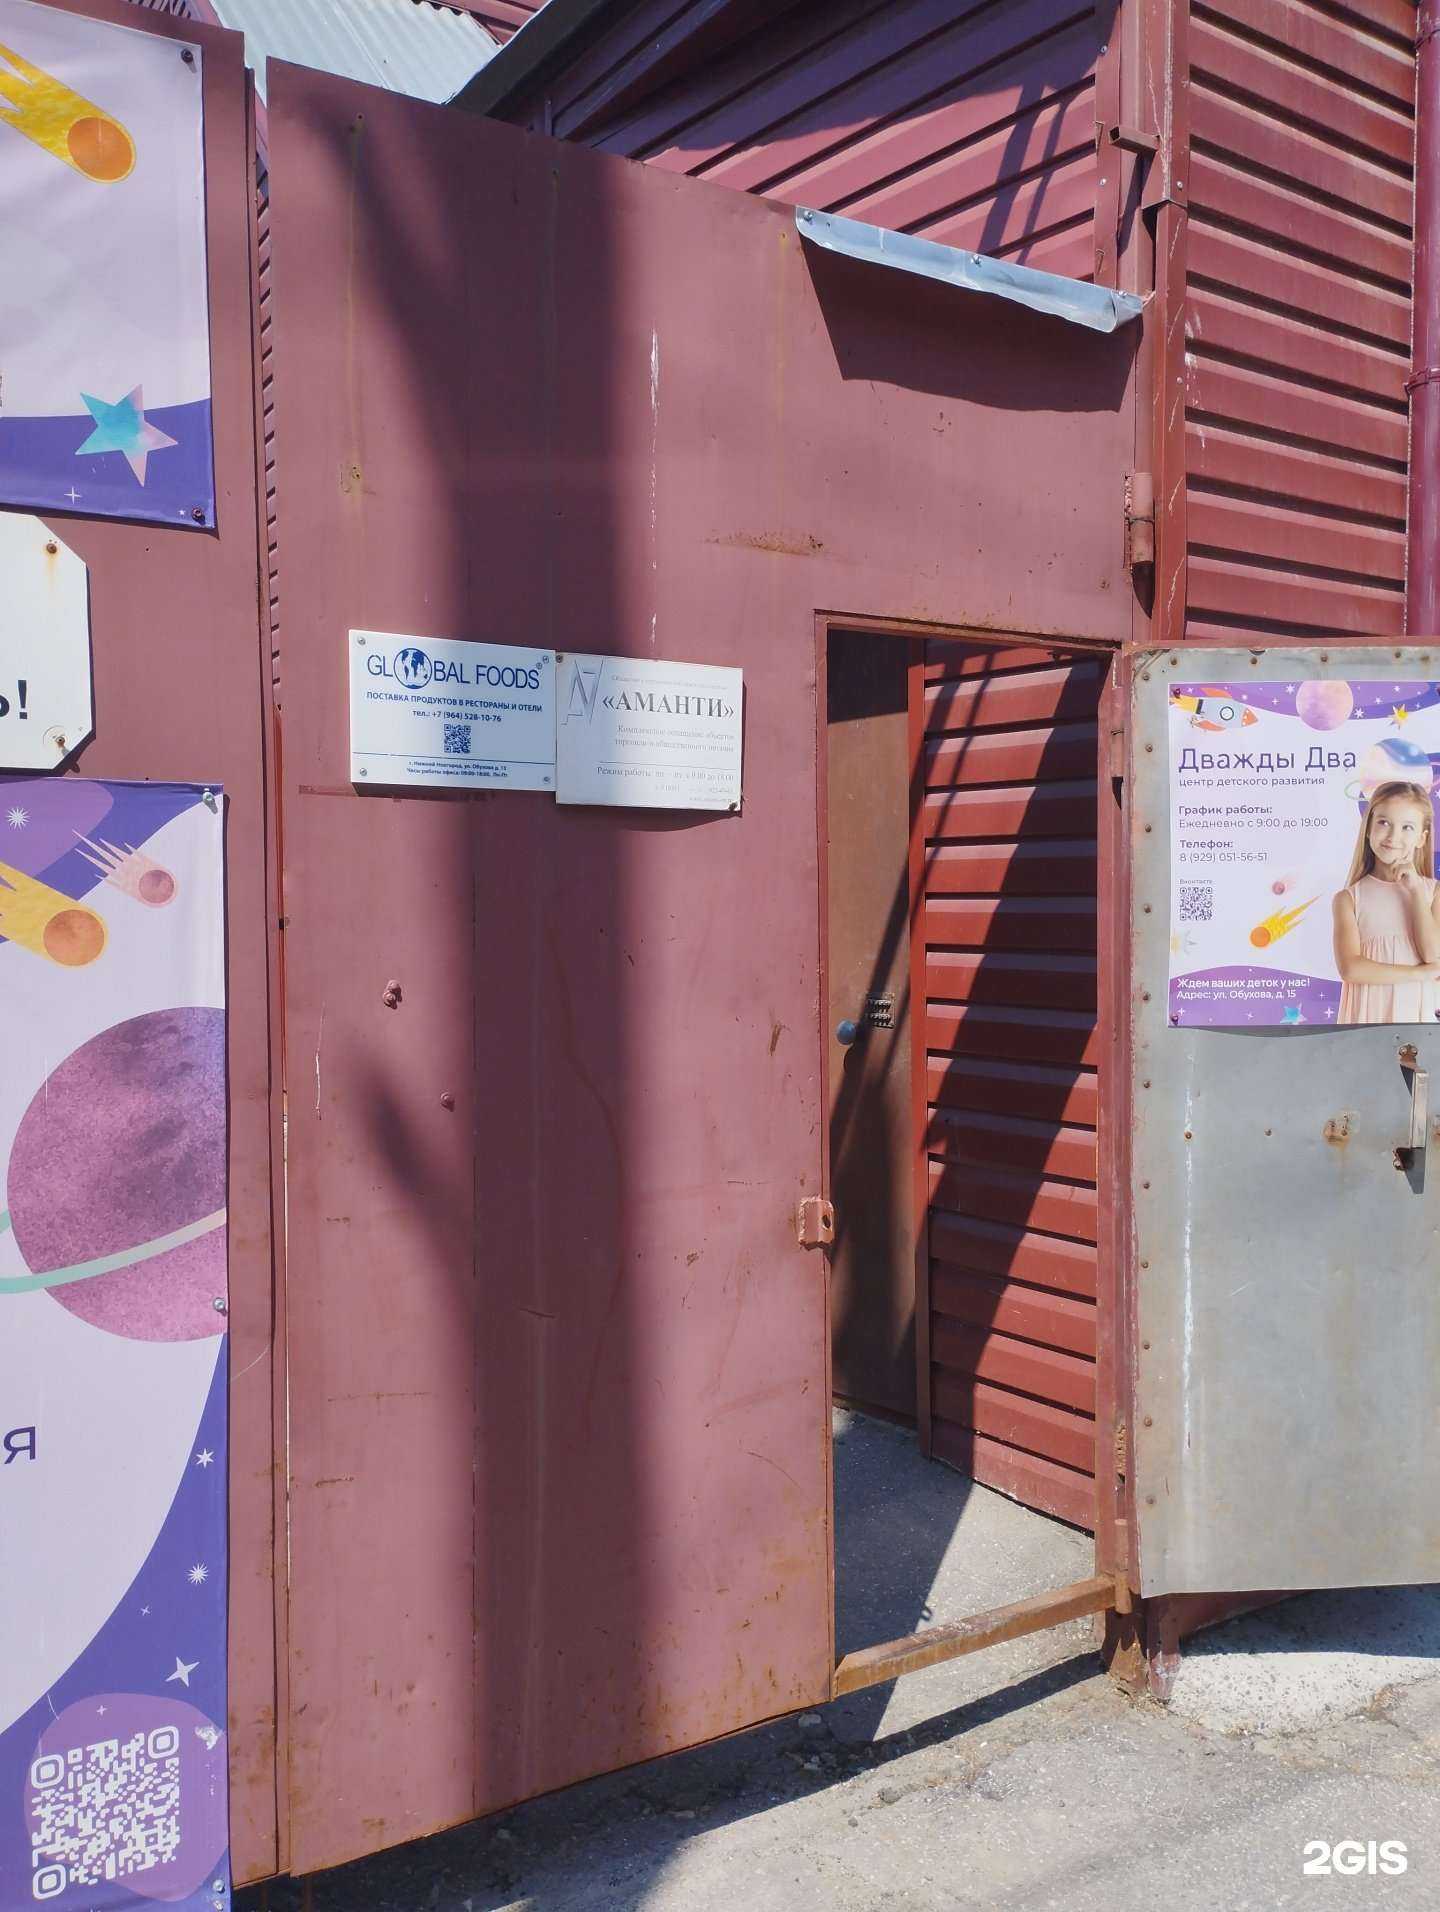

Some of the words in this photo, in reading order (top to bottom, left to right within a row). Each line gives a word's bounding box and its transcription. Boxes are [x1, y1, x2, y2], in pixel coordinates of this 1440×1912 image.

[367, 648, 471, 690] GLOBAL
[366, 691, 409, 702] ПОСТАВКА
[411, 695, 457, 706] ПРОДУКТОВ
[458, 698, 464, 706] В
[465, 699, 510, 710] РЕСТОРАНЫ
[518, 704, 543, 712] ОТЕЛИ
[602, 690, 735, 719] «АМАНТИ»
[443, 711, 463, 720] (964)
[464, 713, 502, 722] 528-10-76
[1179, 748, 1295, 773] Дважды
[1305, 746, 1356, 772] Два
[597, 766, 623, 776] Режим
[1179, 778, 1214, 788] центр
[1217, 777, 1269, 787] детского
[1271, 777, 1325, 788] развития
[1179, 805, 1223, 816] График
[1226, 805, 1273, 816] работы:
[1179, 819, 1245, 829] Ежедневно
[1247, 820, 1254, 828] с
[1256, 818, 1281, 828] 9:00
[1283, 819, 1298, 829] до
[1300, 818, 1329, 828] 19:00
[1179, 840, 1234, 850] Телефон:
[1179, 853, 1187, 862] 8
[1189, 852, 1216, 864] (929)
[1218, 852, 1268, 862] 051-56-51
[1177, 978, 1210, 989] Ждем
[1211, 979, 1246, 989] ваших
[1246, 979, 1279, 989] деток
[1280, 980, 1287, 990] у
[1288, 977, 1311, 988] нас!
[1176, 990, 1211, 1000] Адрес:
[1213, 991, 1228, 1000] ул.
[1287, 989, 1297, 998] 15
